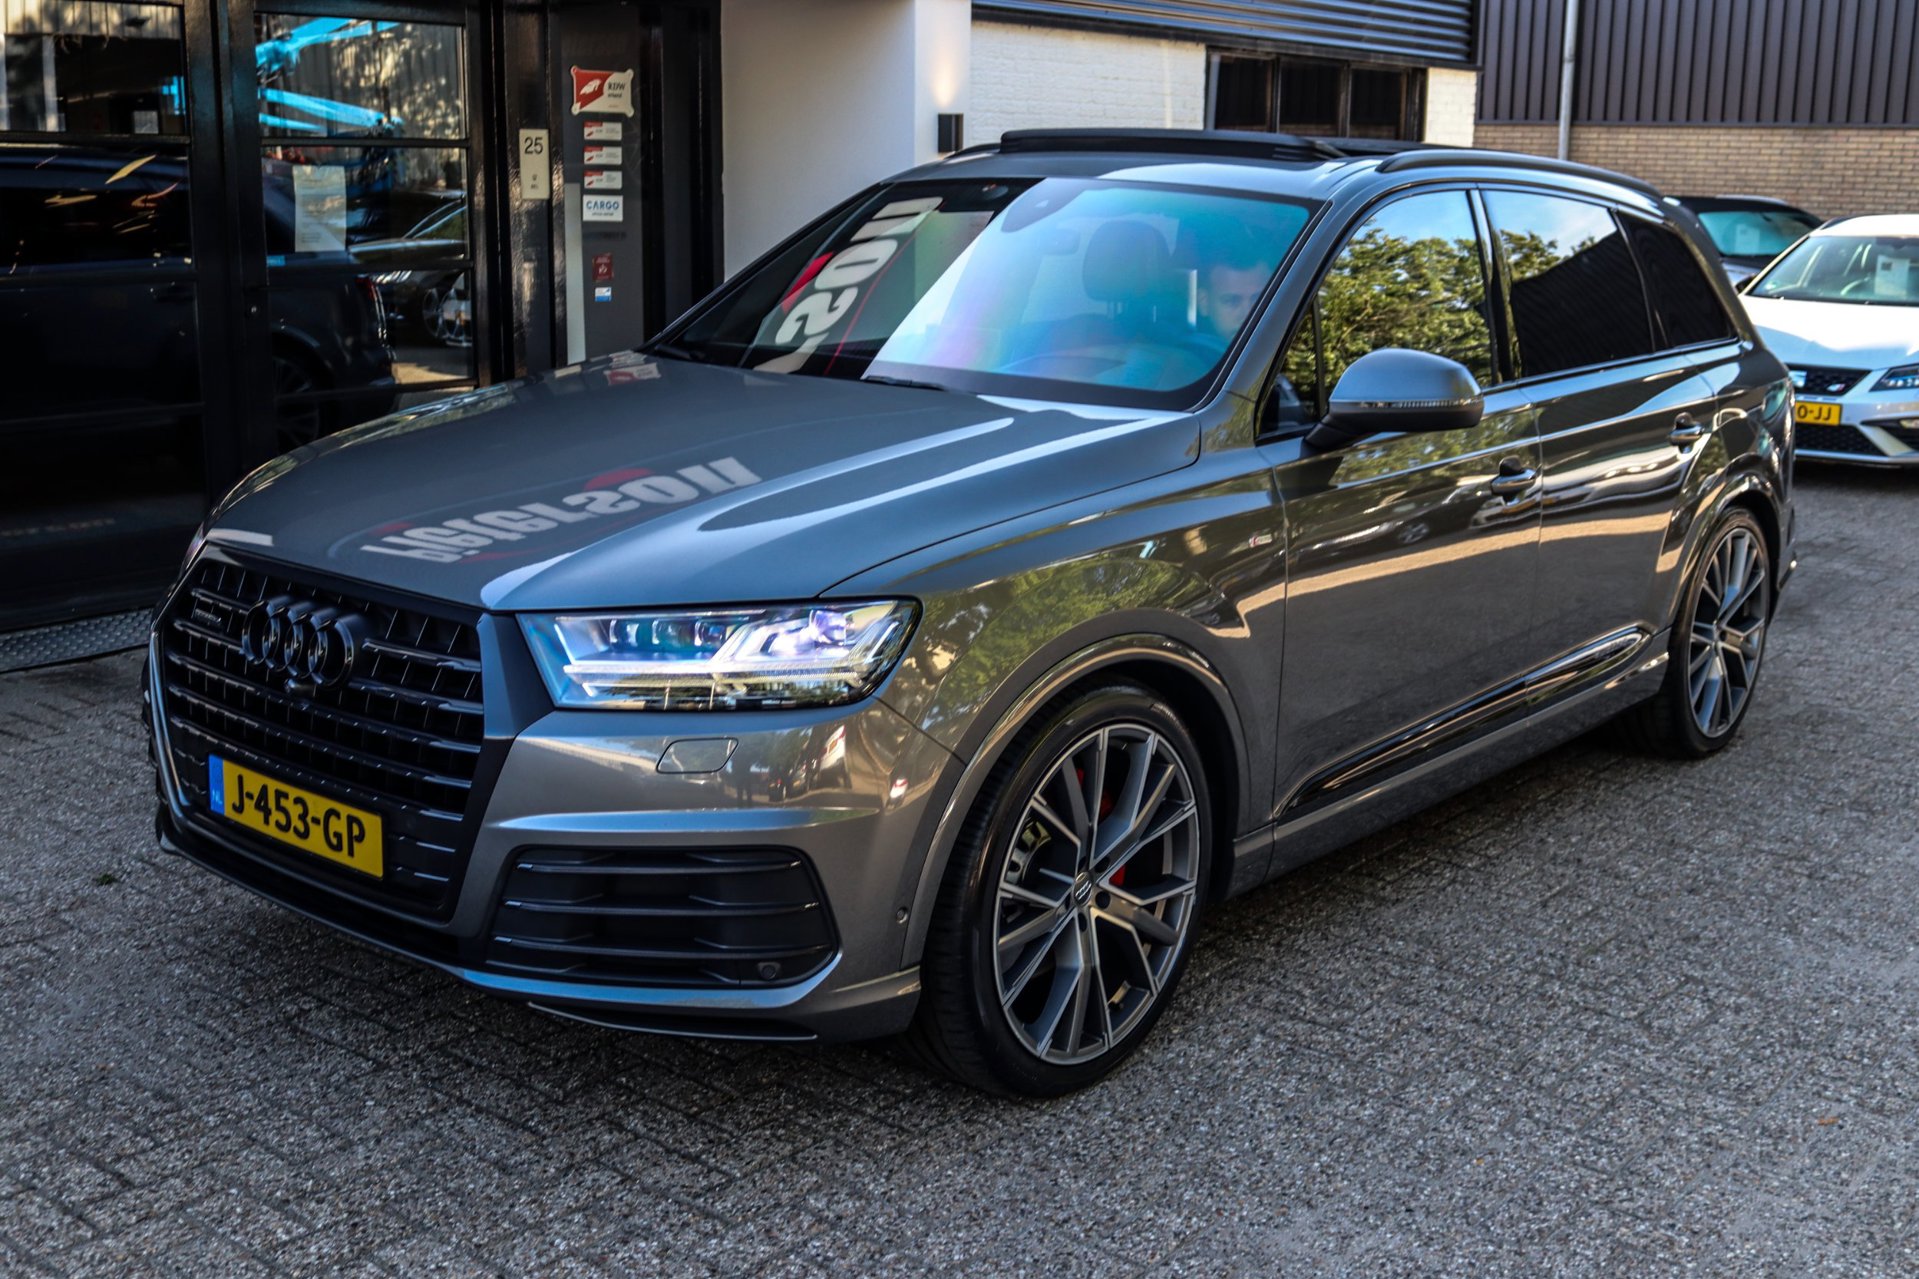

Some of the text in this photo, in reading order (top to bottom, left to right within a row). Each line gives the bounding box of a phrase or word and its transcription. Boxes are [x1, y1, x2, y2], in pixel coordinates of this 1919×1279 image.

[524, 136, 543, 155] 25
[586, 200, 620, 211] CARGO
[231, 773, 366, 858] J-453-GP
